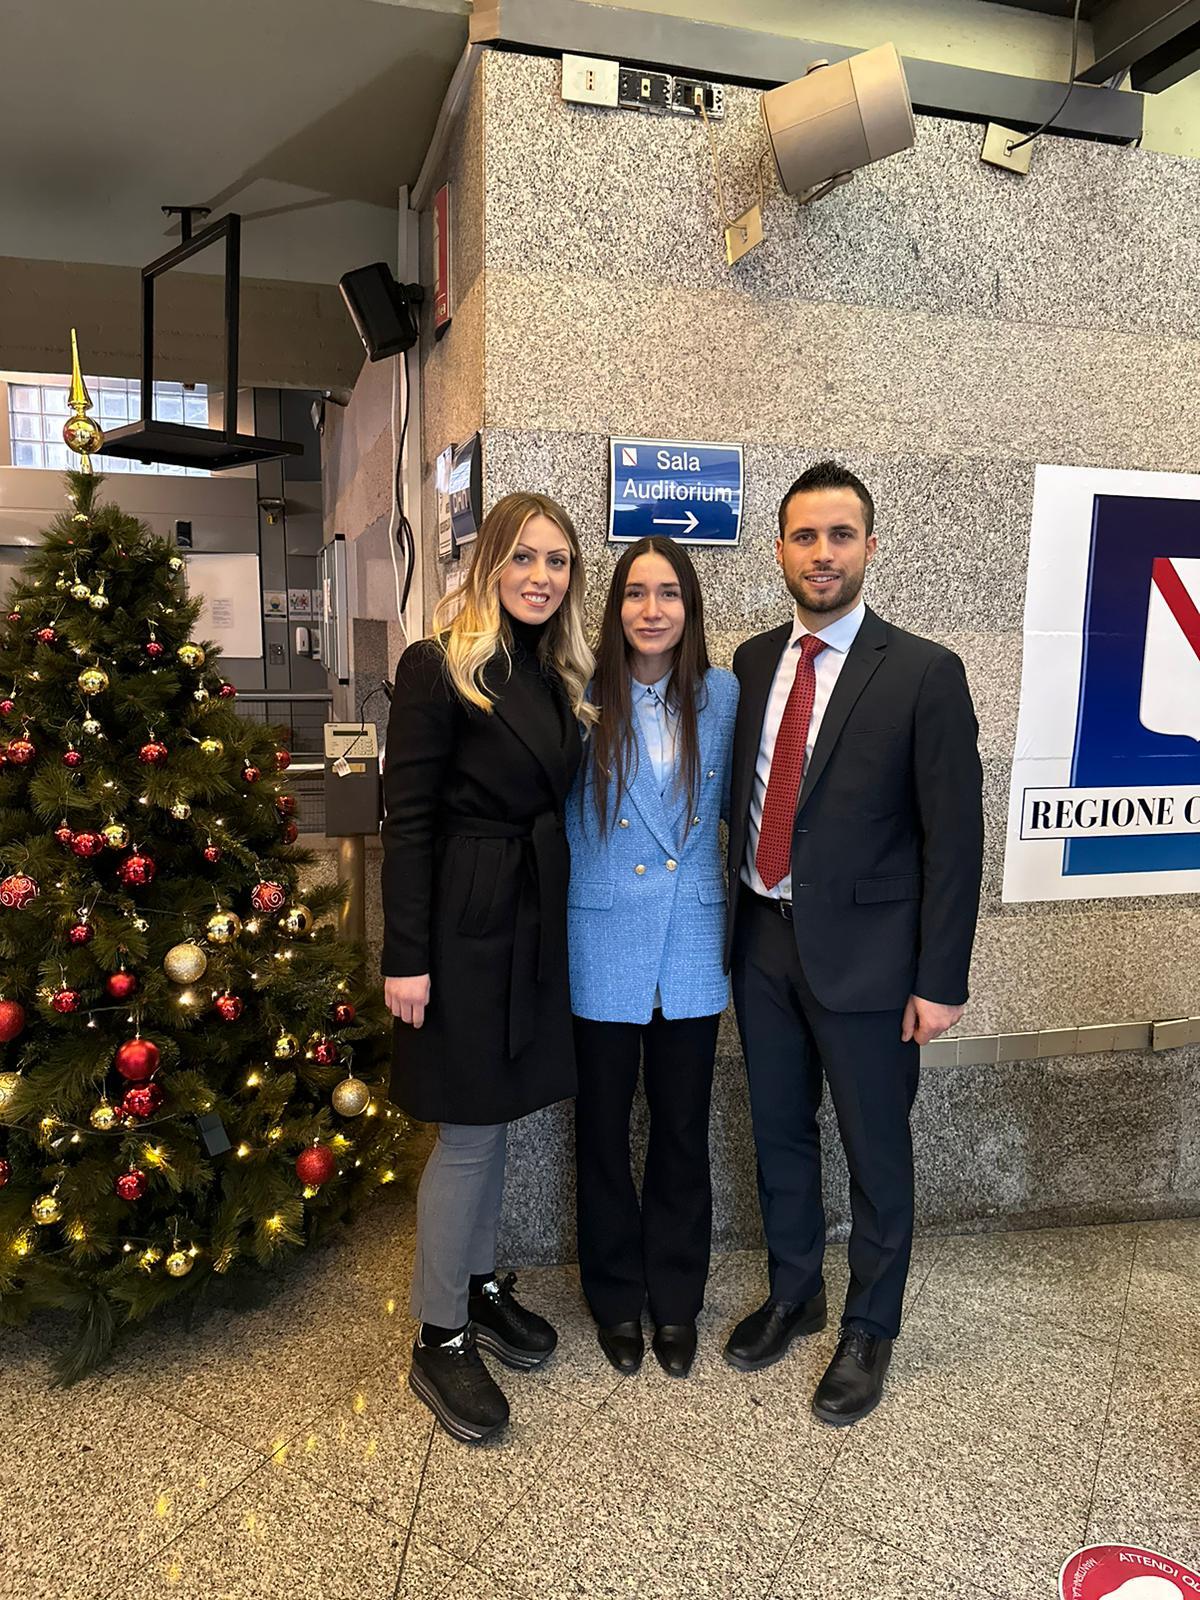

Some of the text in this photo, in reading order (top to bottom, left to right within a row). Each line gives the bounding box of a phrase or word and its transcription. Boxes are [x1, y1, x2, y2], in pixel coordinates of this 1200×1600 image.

[656, 450, 701, 472] Sala
[622, 478, 732, 502] Auditorium
[1030, 797, 1174, 830] REGIONE
[1119, 1552, 1179, 1578] ATTENDI
